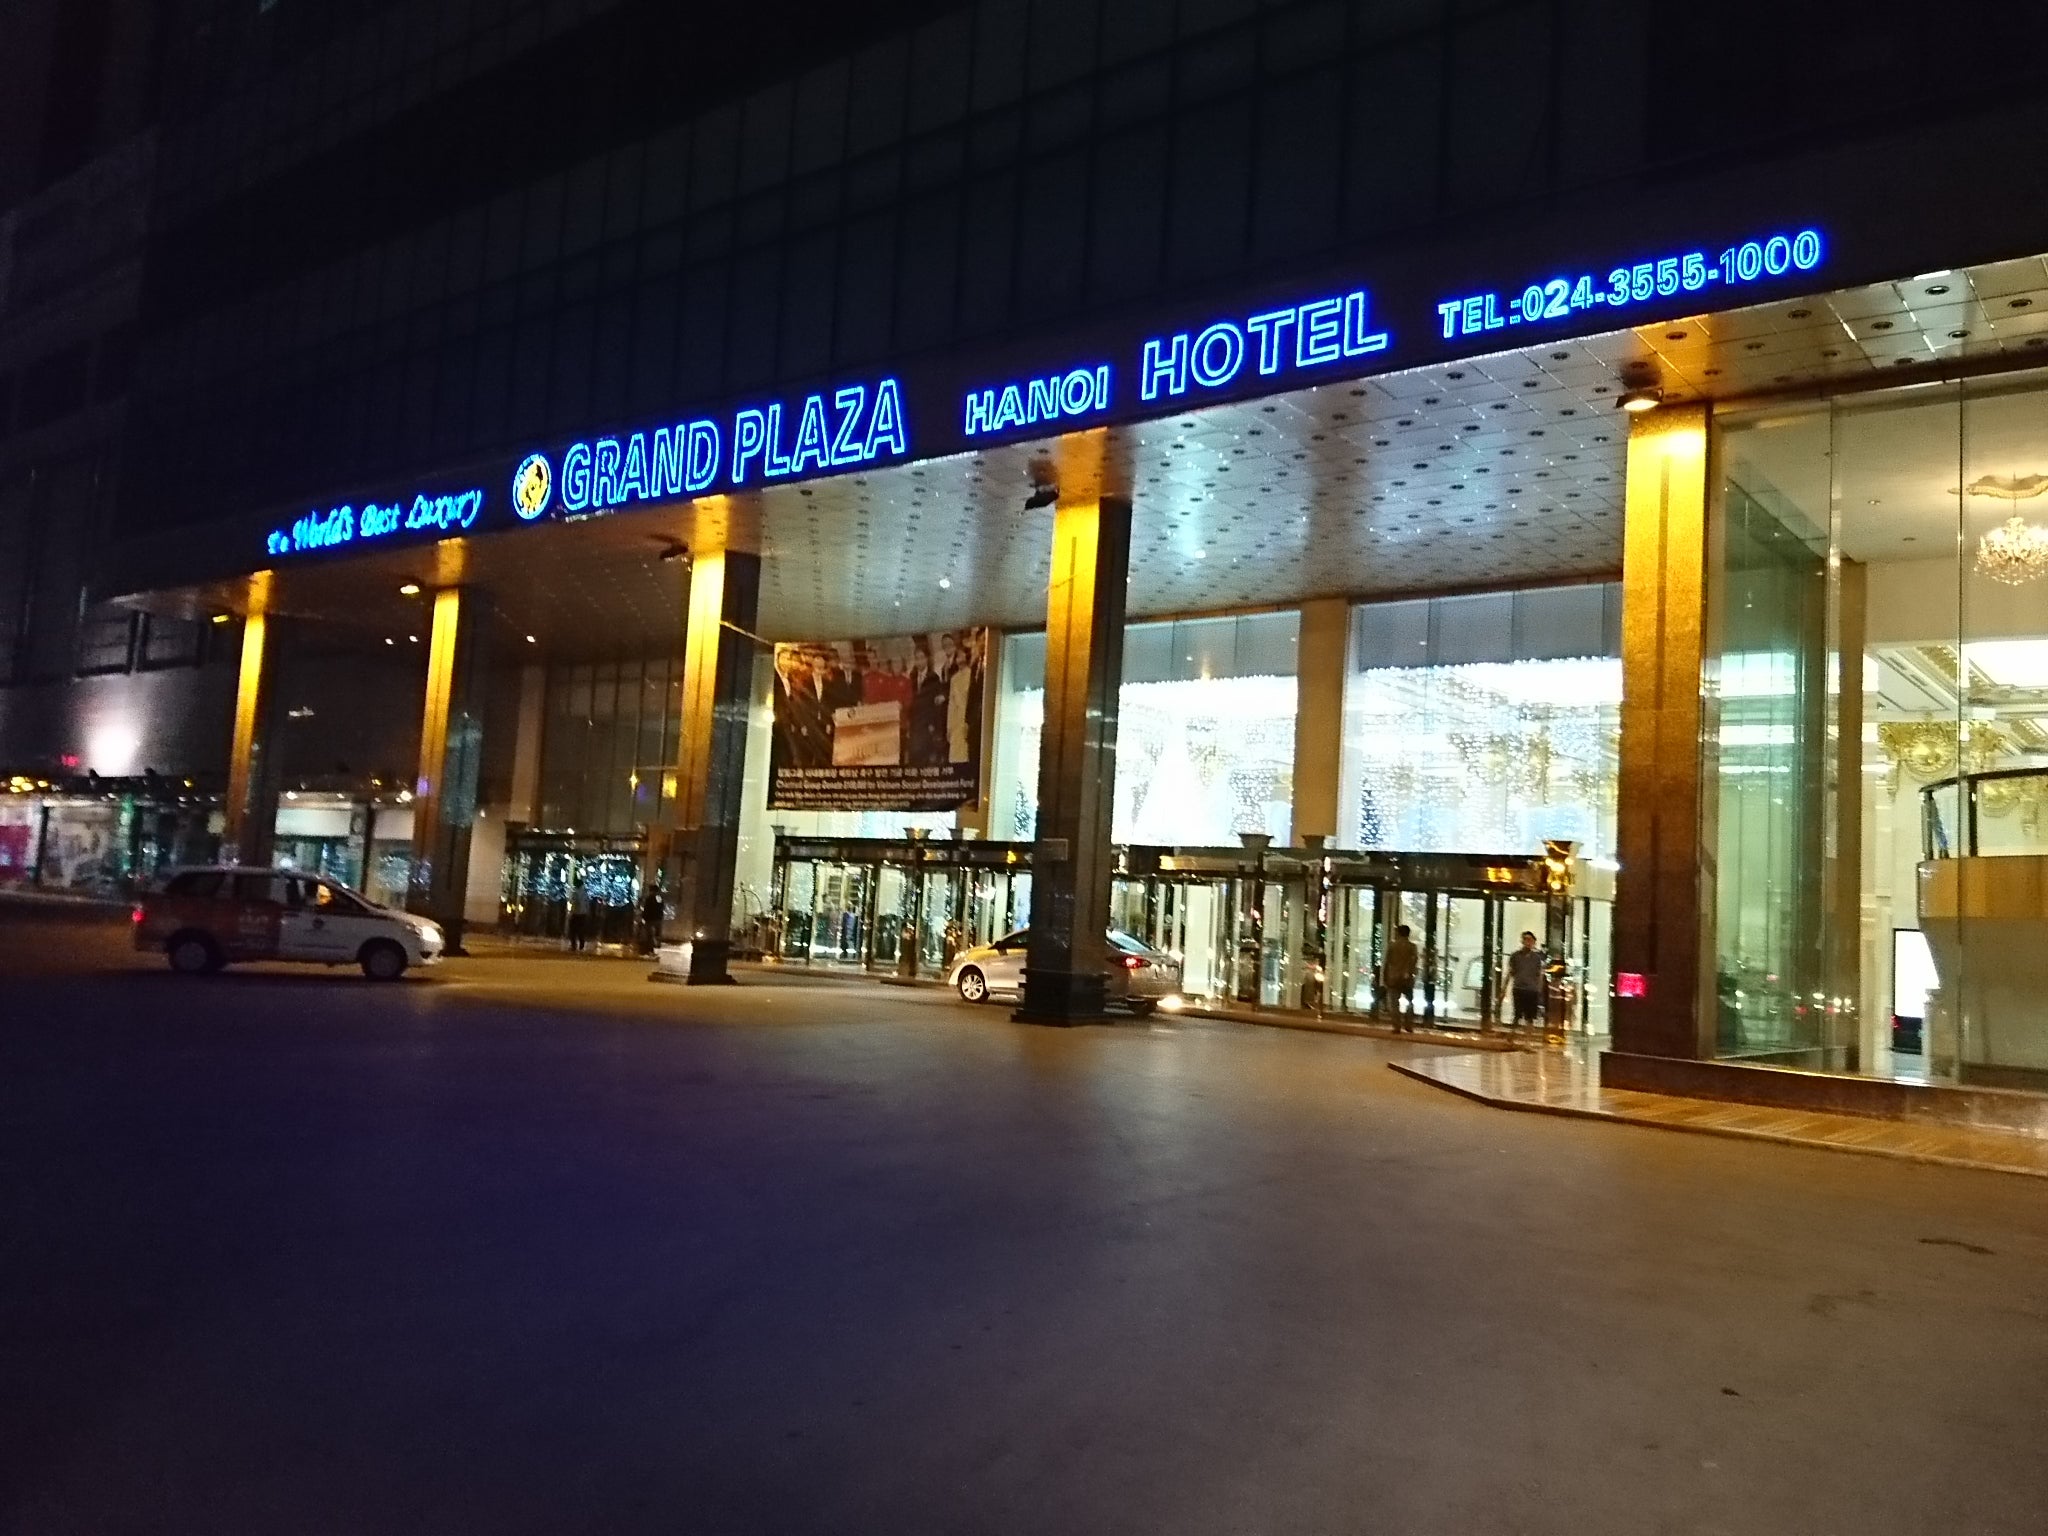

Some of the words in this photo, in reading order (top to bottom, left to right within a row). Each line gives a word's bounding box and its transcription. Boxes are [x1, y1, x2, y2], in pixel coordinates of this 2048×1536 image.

[561, 419, 720, 511] GRAND
[731, 378, 906, 484] PLAZA
[964, 365, 1110, 436] HANOI
[1141, 291, 1389, 401] HOTEL
[359, 502, 401, 537] Best
[404, 489, 483, 529] Luxury
